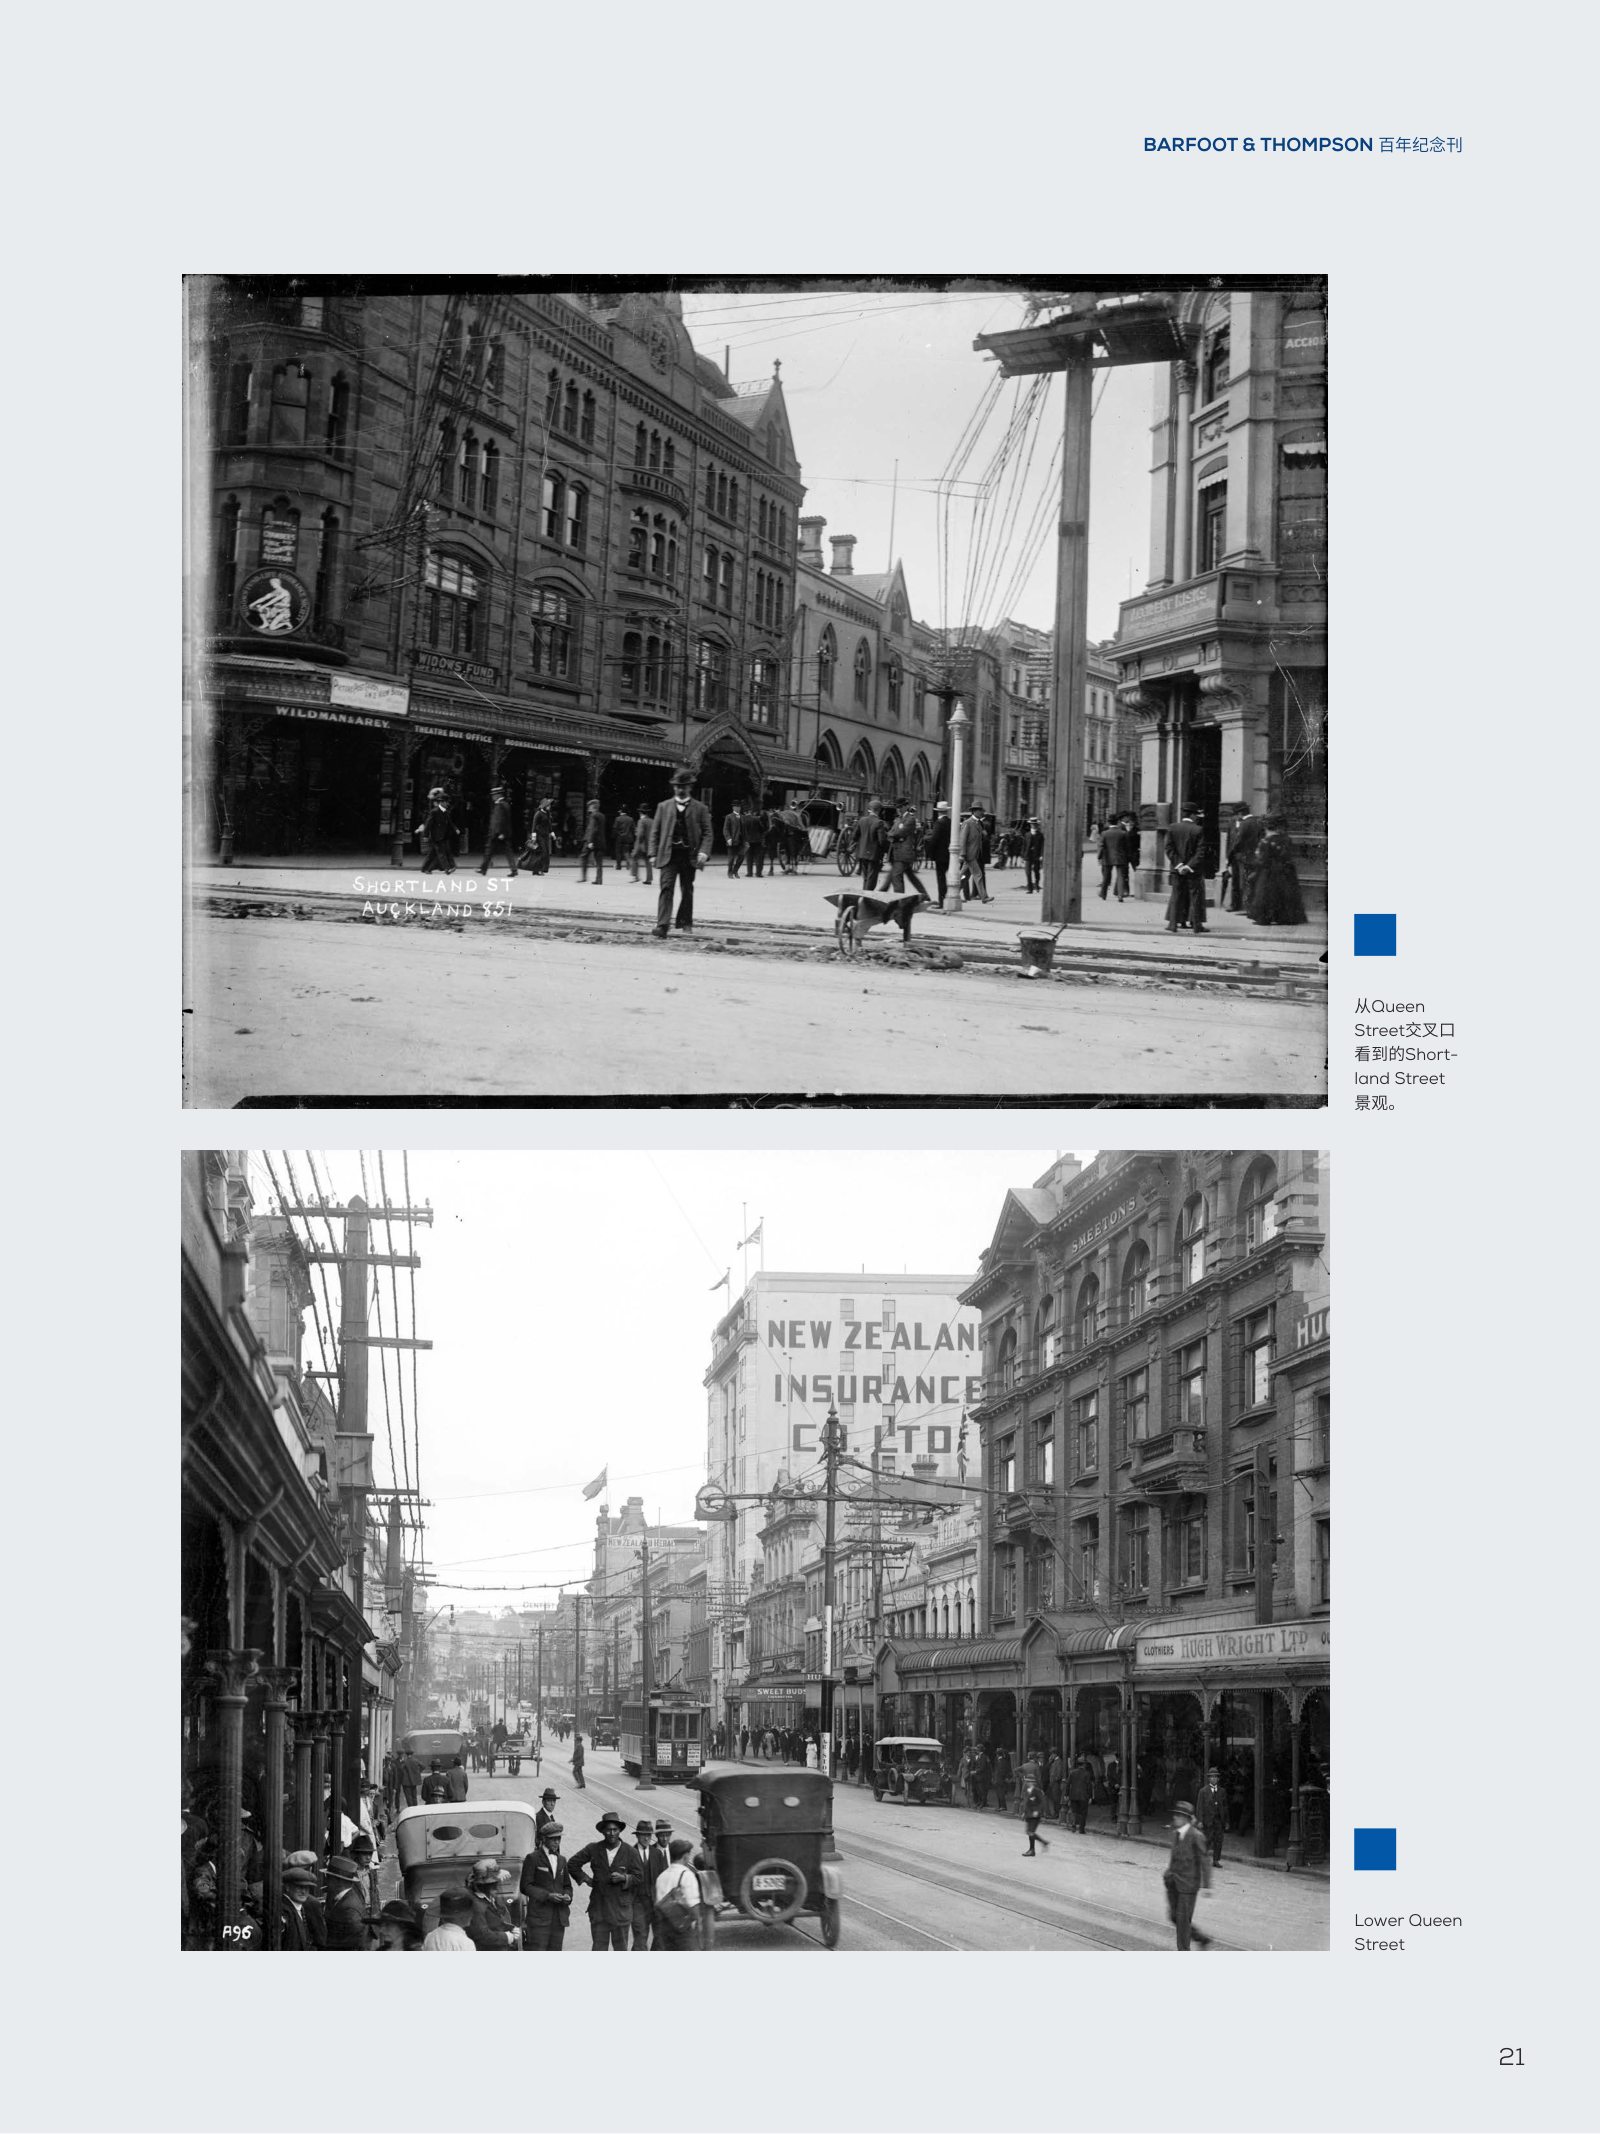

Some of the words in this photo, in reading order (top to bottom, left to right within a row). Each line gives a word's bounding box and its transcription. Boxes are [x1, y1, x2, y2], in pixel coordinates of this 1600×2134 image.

[466, 663, 494, 678] FUND
[414, 724, 448, 737] THEATRE
[449, 730, 464, 739] BOX
[465, 732, 493, 743] OFFICE
[768, 1320, 832, 1349] NEW
[844, 1320, 983, 1351] ZEALAN
[775, 1374, 982, 1404] INSURANCE
[874, 1425, 951, 1454] LTD
[1143, 1645, 1174, 1657] CLOTHIERS
[1181, 1637, 1214, 1660] HUGH
[1215, 1632, 1276, 1657] WRIGHT
[757, 1688, 784, 1696] SWEET
[786, 1688, 808, 1696] BUDS
